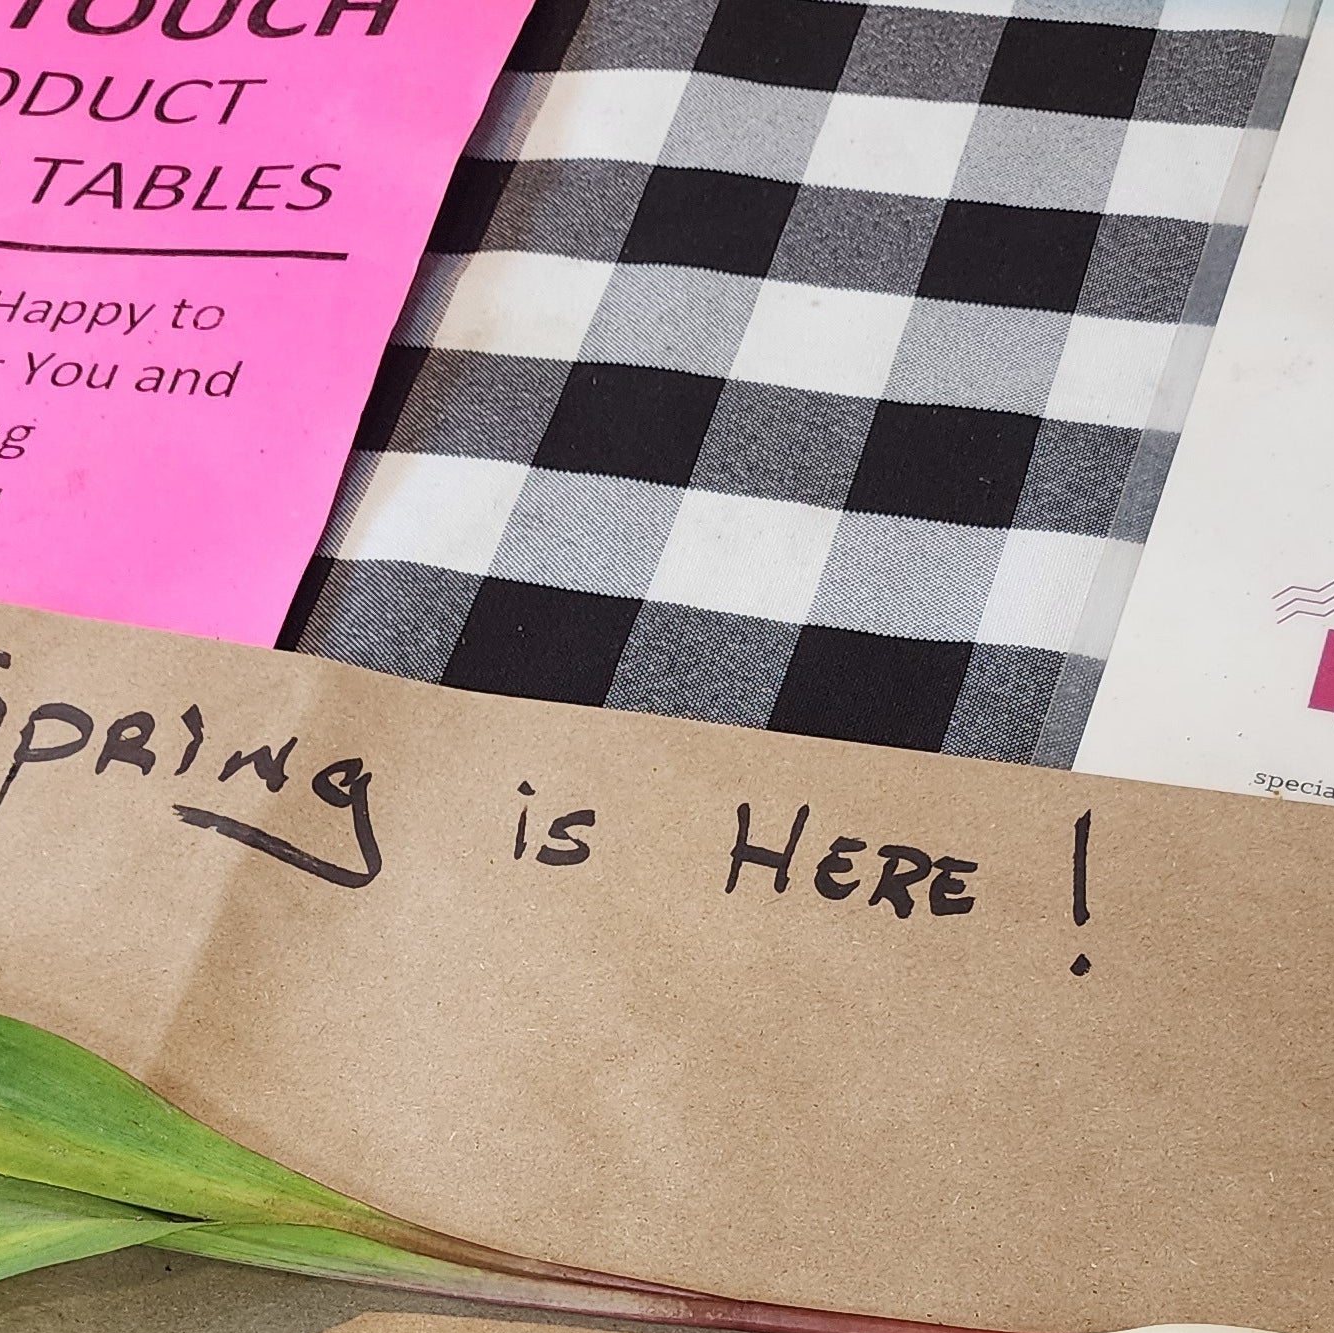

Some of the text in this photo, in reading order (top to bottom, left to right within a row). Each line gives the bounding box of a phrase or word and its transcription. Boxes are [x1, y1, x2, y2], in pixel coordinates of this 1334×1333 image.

[32, 157, 341, 211] TABLES
[172, 299, 225, 330] to
[25, 352, 118, 389] You
[135, 361, 243, 397] and
[514, 782, 595, 866] is
